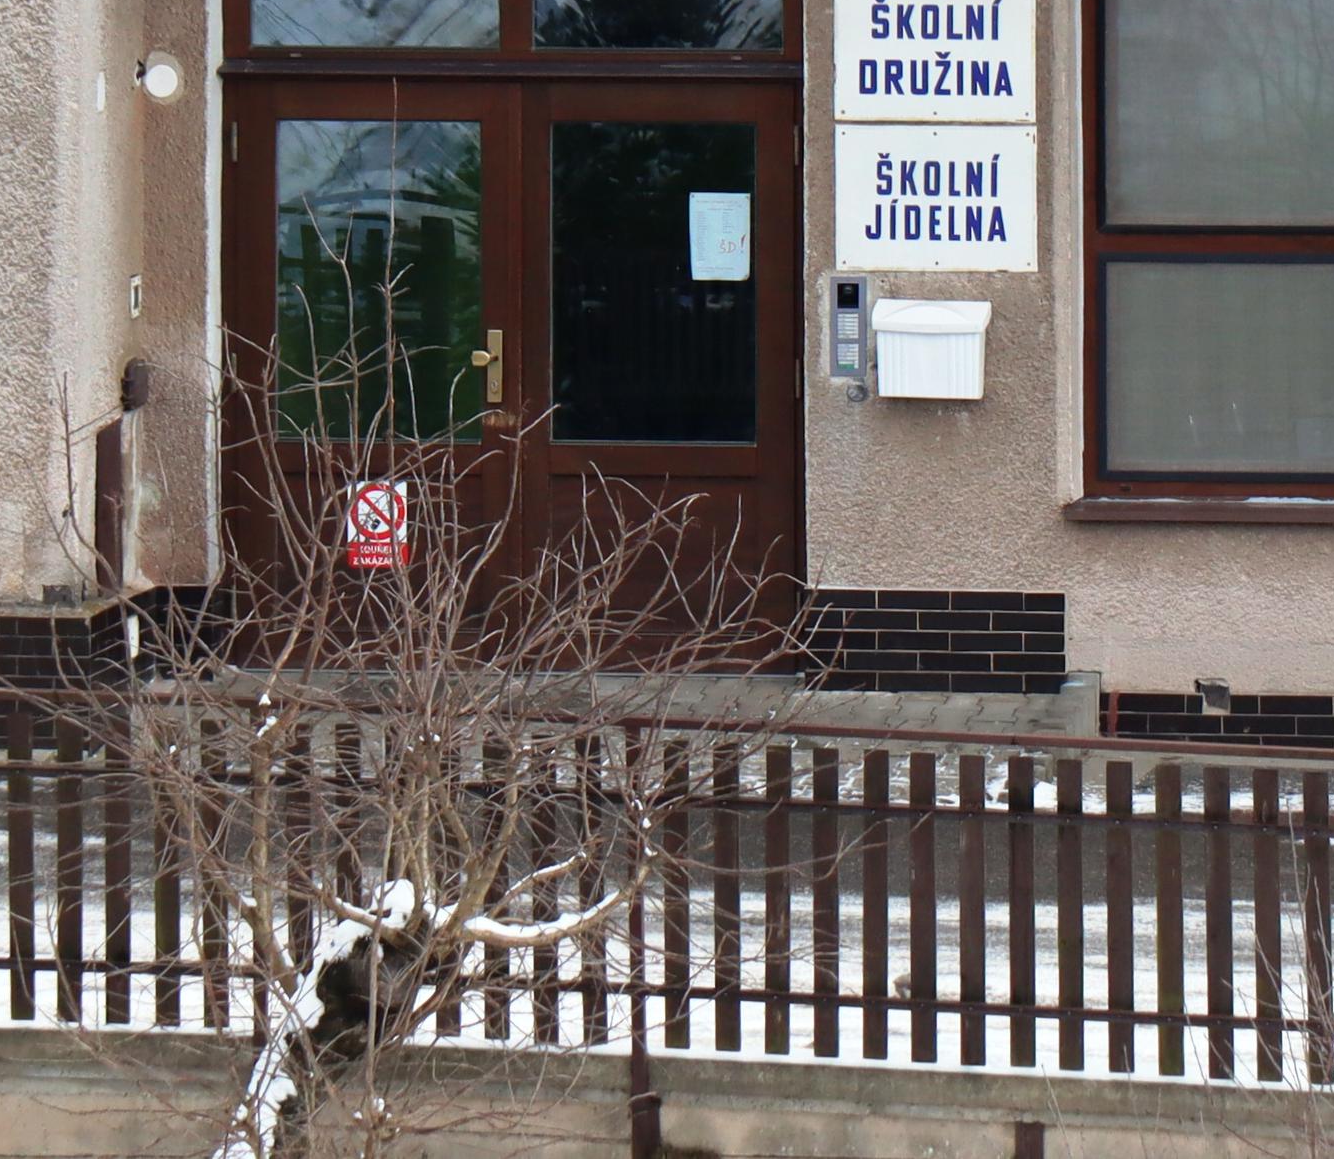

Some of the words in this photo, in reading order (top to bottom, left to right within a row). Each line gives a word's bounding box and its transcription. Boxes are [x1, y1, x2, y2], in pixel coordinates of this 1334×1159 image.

[859, 52, 1013, 97] DRUŽINA
[876, 153, 1001, 197] ŠKOLNÍ
[865, 198, 1007, 242] JÍDELNA
